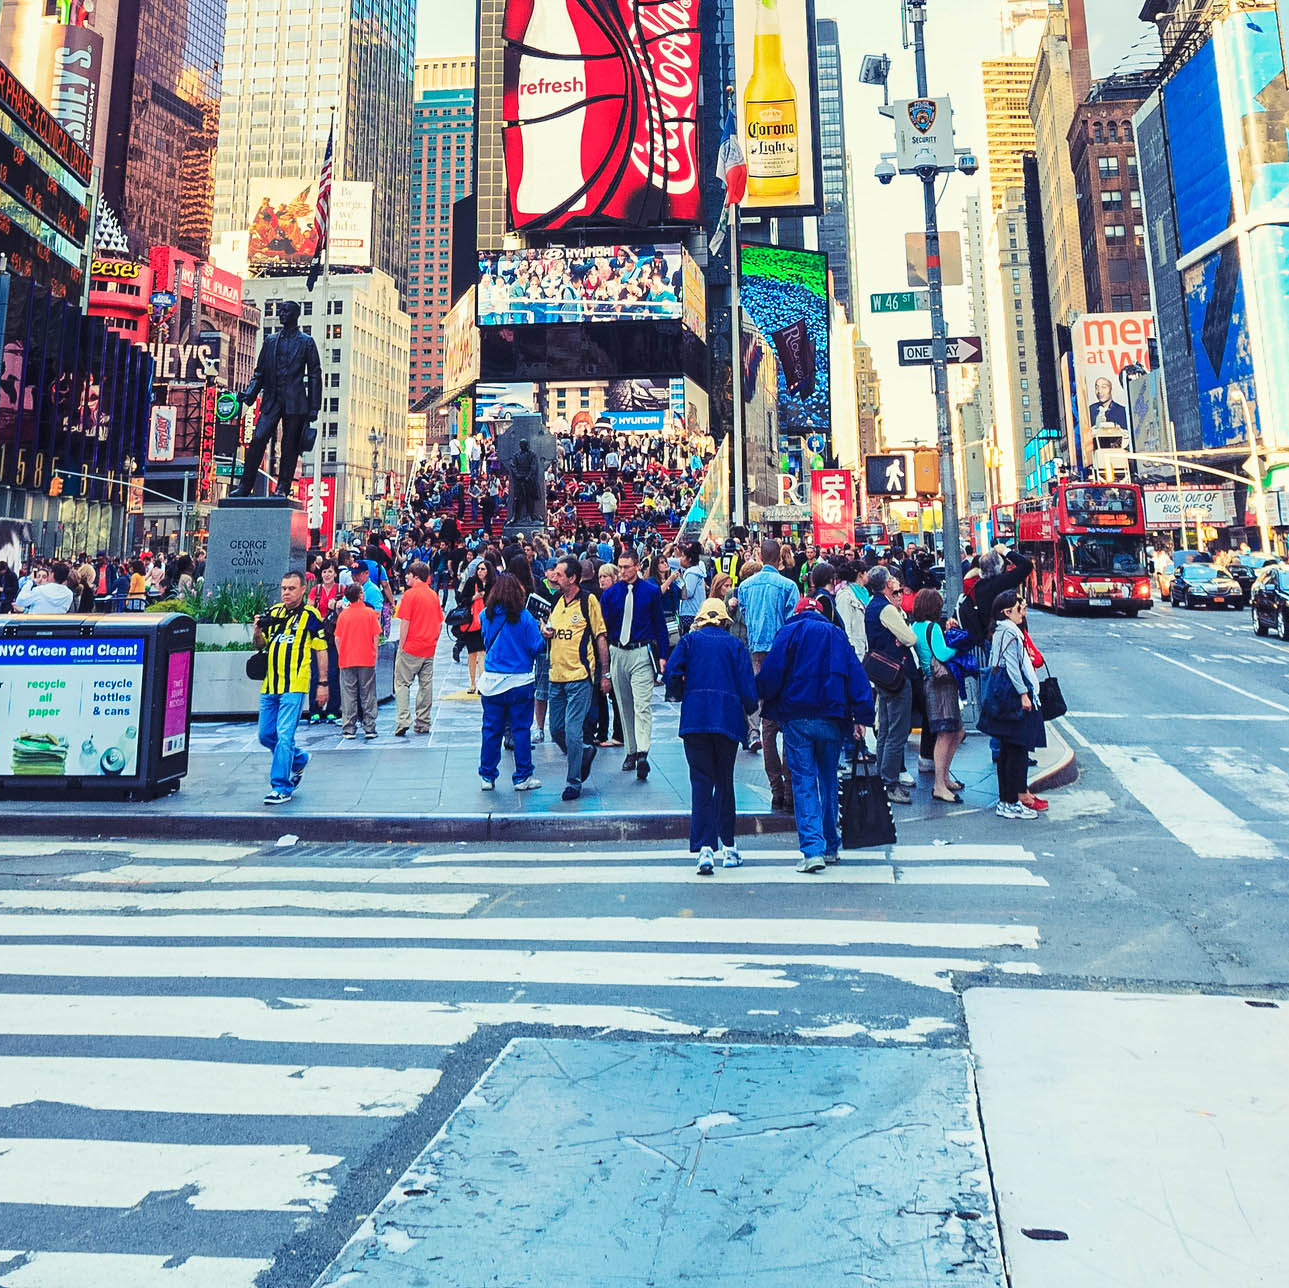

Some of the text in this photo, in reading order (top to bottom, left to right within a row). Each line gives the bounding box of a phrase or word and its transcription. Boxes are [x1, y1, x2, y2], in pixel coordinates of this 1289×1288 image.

[519, 76, 584, 95] refresh
[86, 82, 97, 141] CHOCOLATE
[6, 76, 34, 127] PHASE
[34, 105, 40, 130] 3
[40, 112, 69, 160] CLINICAL
[748, 122, 794, 140] Corona
[912, 136, 937, 144] SECURITY
[759, 141, 785, 154] Light
[565, 246, 616, 259] HYUNDAI
[214, 280, 239, 301] PLAZA
[873, 294, 911, 310] W 46 ST
[1087, 348, 1105, 364] at
[618, 416, 660, 426] HYUNDAI
[821, 474, 845, 524] tkts
[1185, 493, 1201, 503] OUT
[1204, 492, 1218, 502] OF
[230, 540, 267, 549] GEORGE
[231, 557, 265, 566] COHAN
[28, 644, 67, 657] Green
[69, 644, 95, 657] and
[97, 643, 138, 656] Clean!
[27, 679, 66, 690] recycle
[93, 679, 133, 689] recycle
[39, 693, 53, 702] all
[93, 692, 132, 702] bottles
[28, 708, 61, 718] paper
[93, 707, 130, 716] & cans
